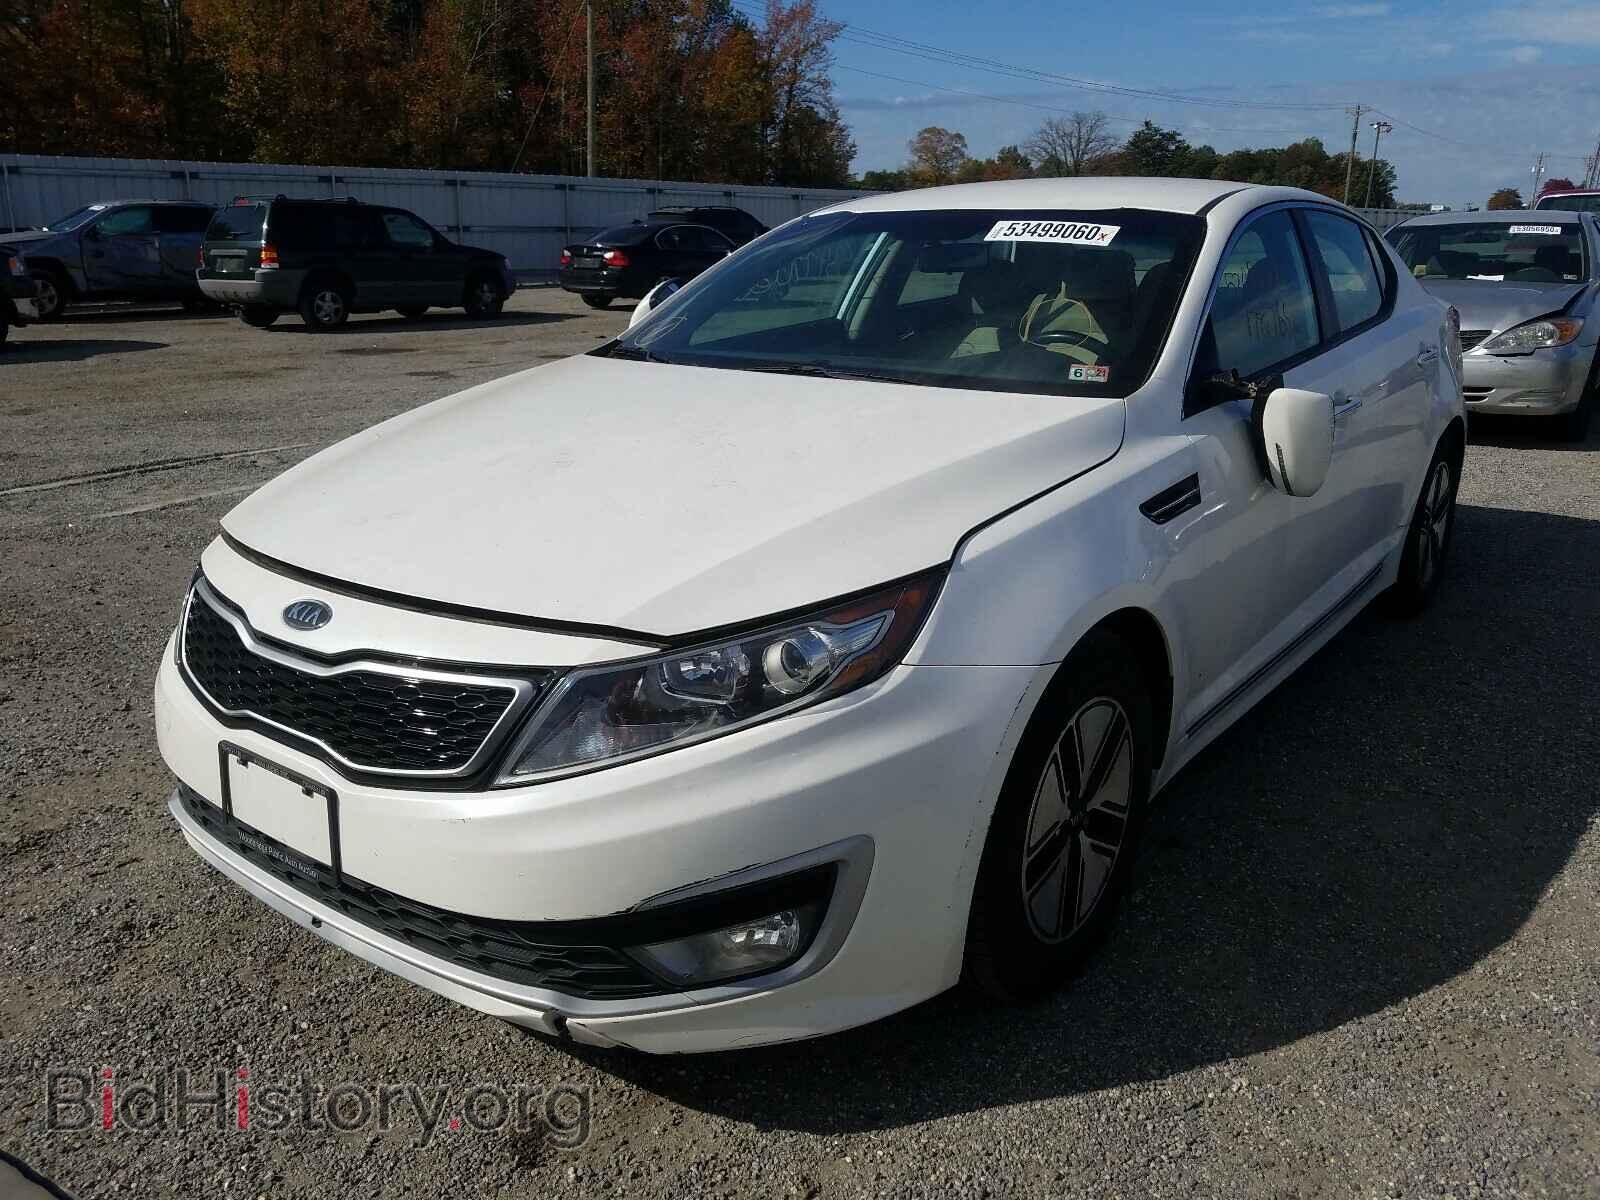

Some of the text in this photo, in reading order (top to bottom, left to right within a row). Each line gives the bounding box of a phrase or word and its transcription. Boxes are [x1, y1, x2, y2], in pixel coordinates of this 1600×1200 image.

[1003, 222, 1101, 241] 53499060
[1073, 368, 1083, 378] 6
[288, 602, 322, 625] KIA
